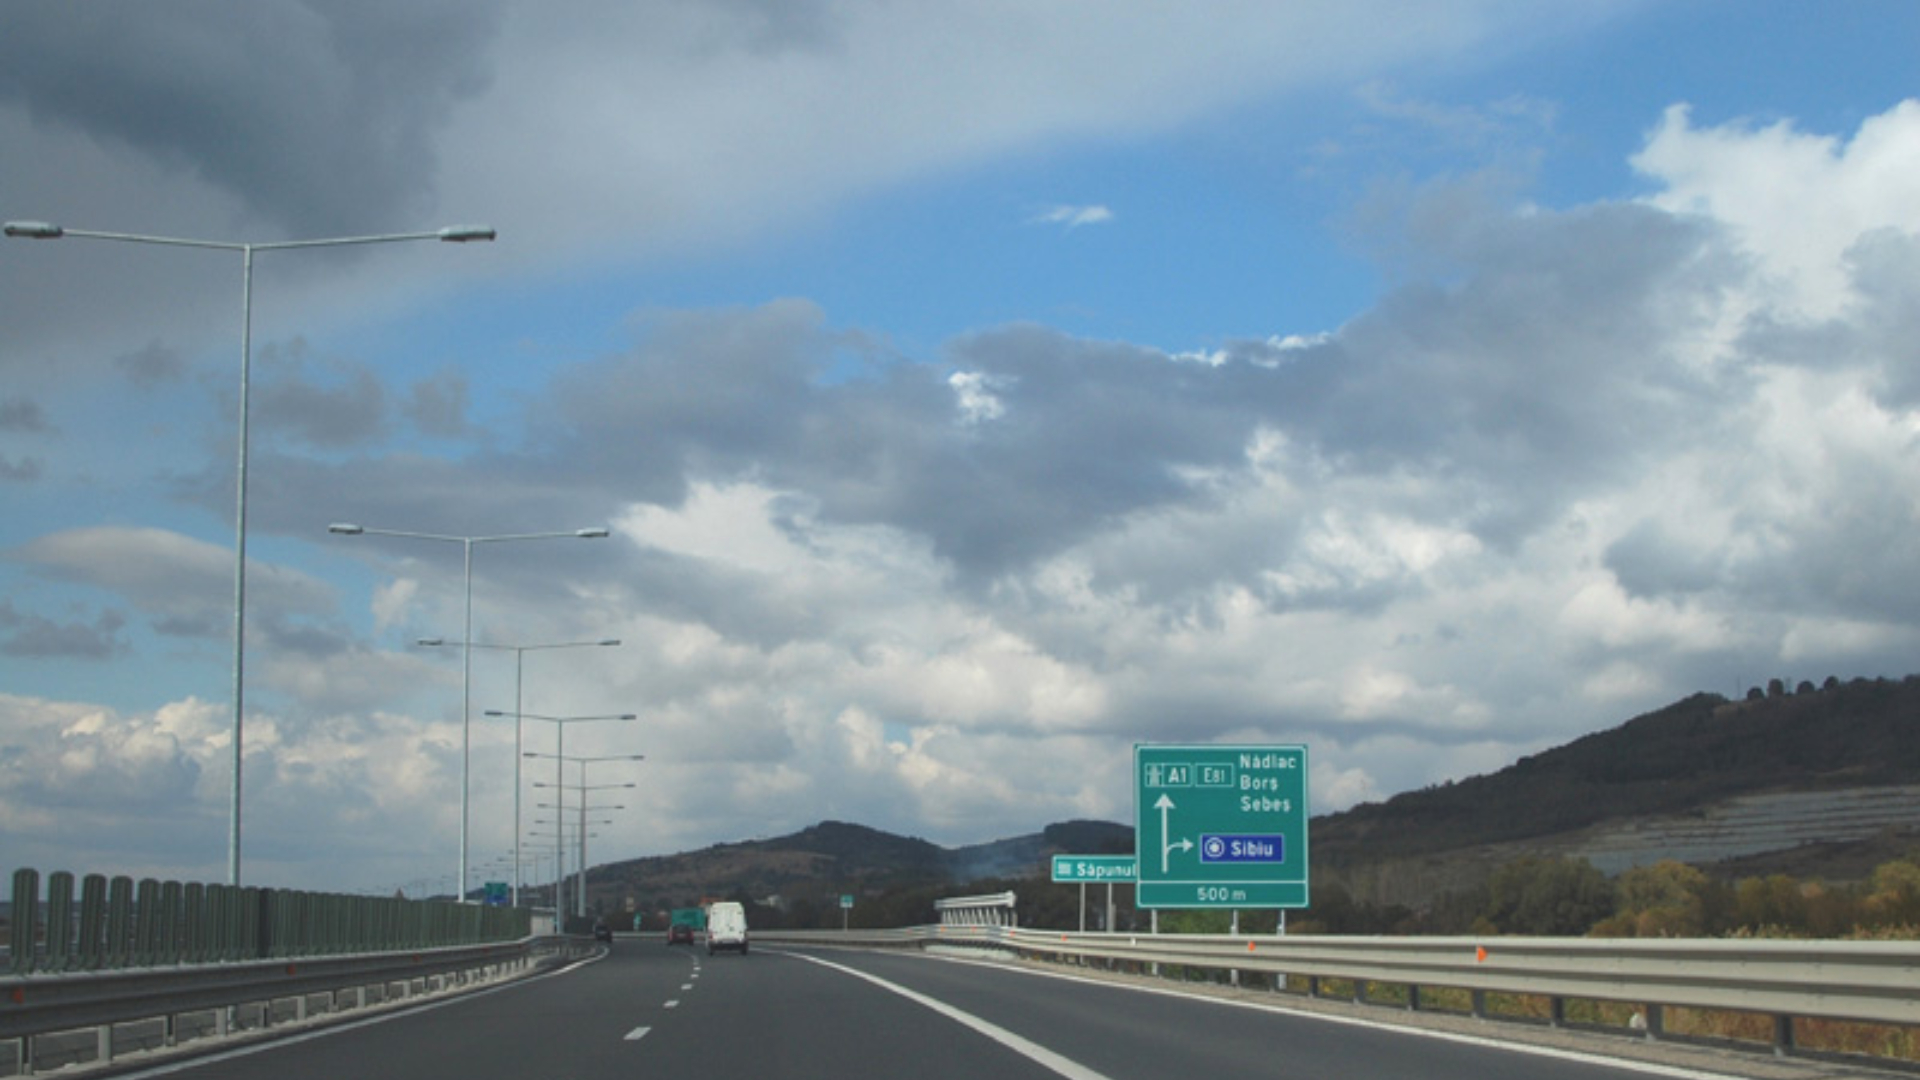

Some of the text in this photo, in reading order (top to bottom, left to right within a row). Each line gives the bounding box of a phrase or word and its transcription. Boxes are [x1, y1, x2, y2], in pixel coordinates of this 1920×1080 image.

[1168, 767, 1186, 783] A1
[1231, 840, 1273, 856] Sibiu
[1197, 887, 1246, 901] 500 m
